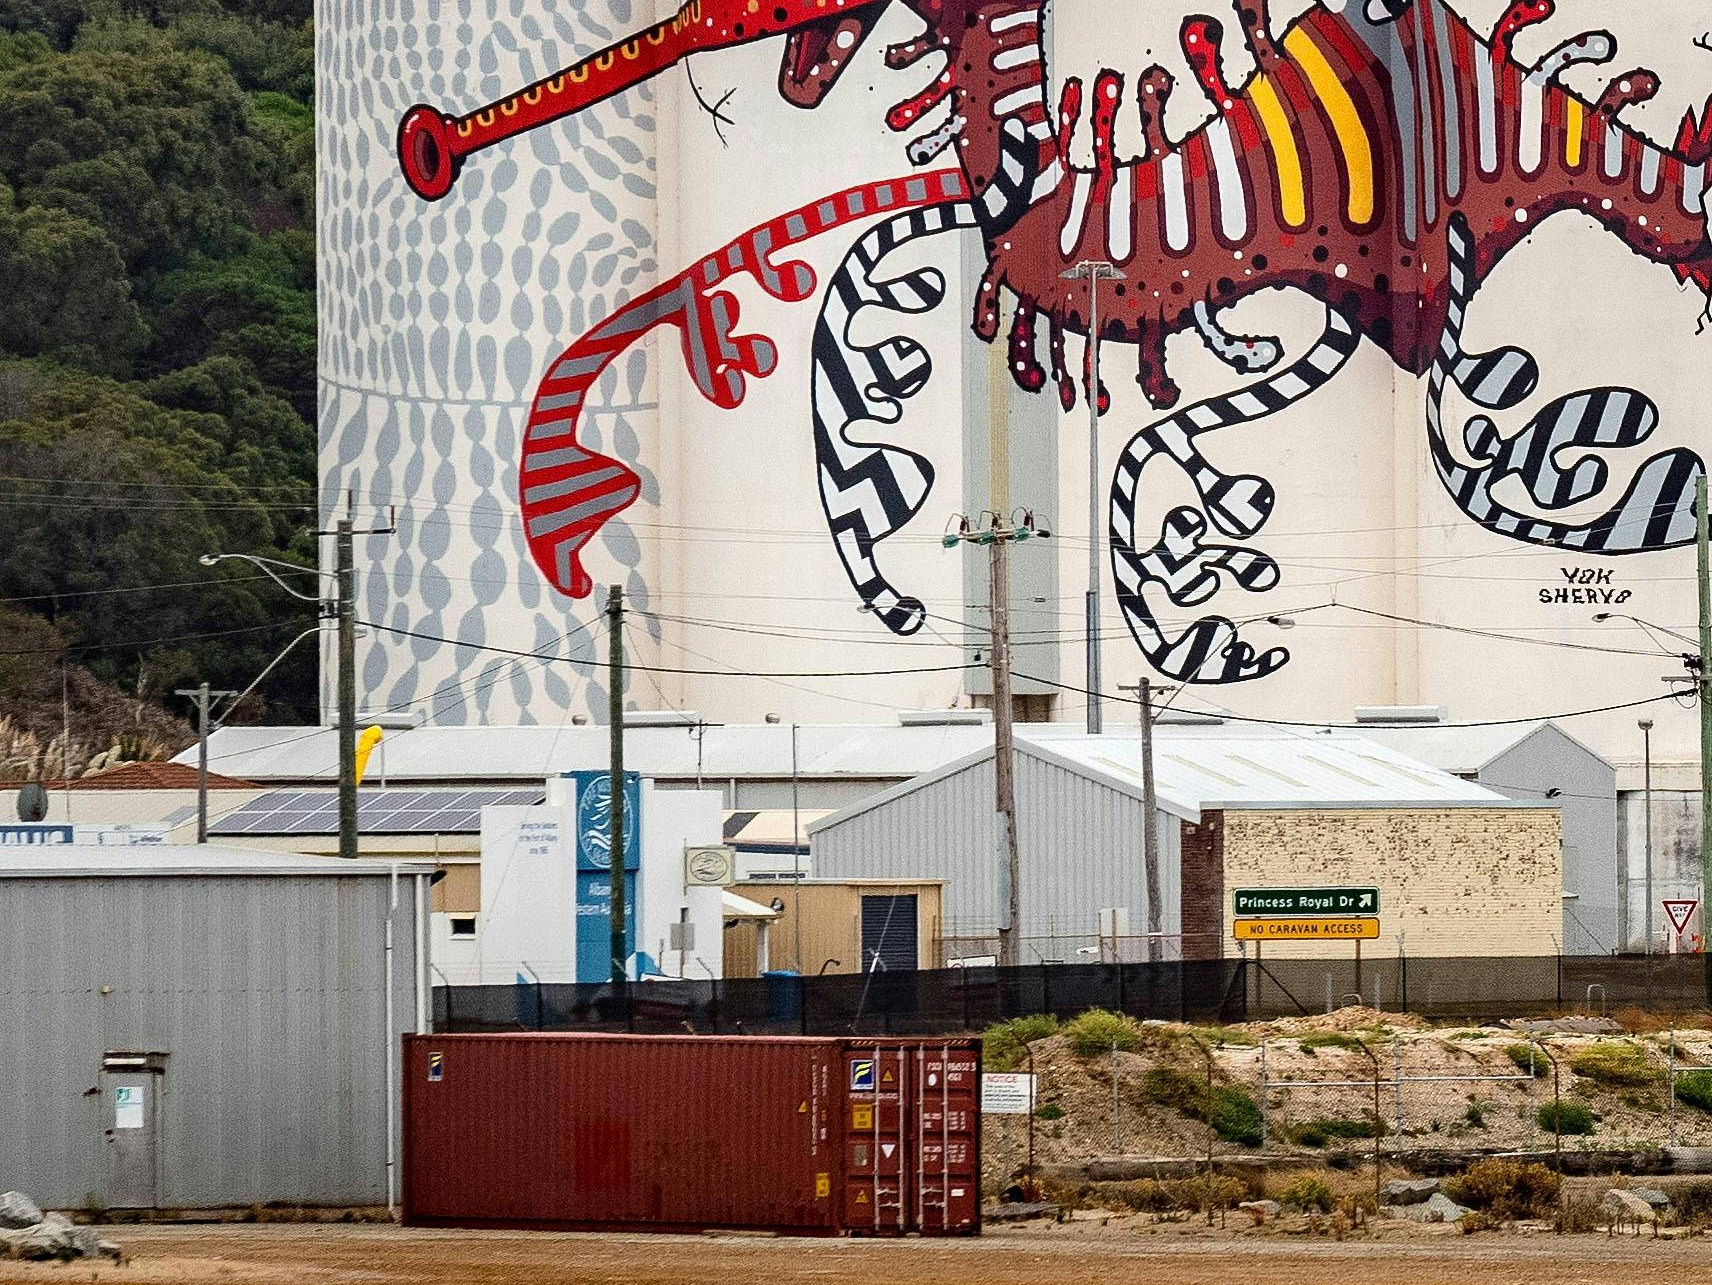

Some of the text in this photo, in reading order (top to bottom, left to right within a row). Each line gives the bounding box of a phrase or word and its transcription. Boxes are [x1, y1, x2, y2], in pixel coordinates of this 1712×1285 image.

[1239, 896, 1354, 910] Princess Royal Dr
[1250, 923, 1363, 934] NO CARAVAN ACCESS
[986, 1075, 1017, 1084] NOTICE
